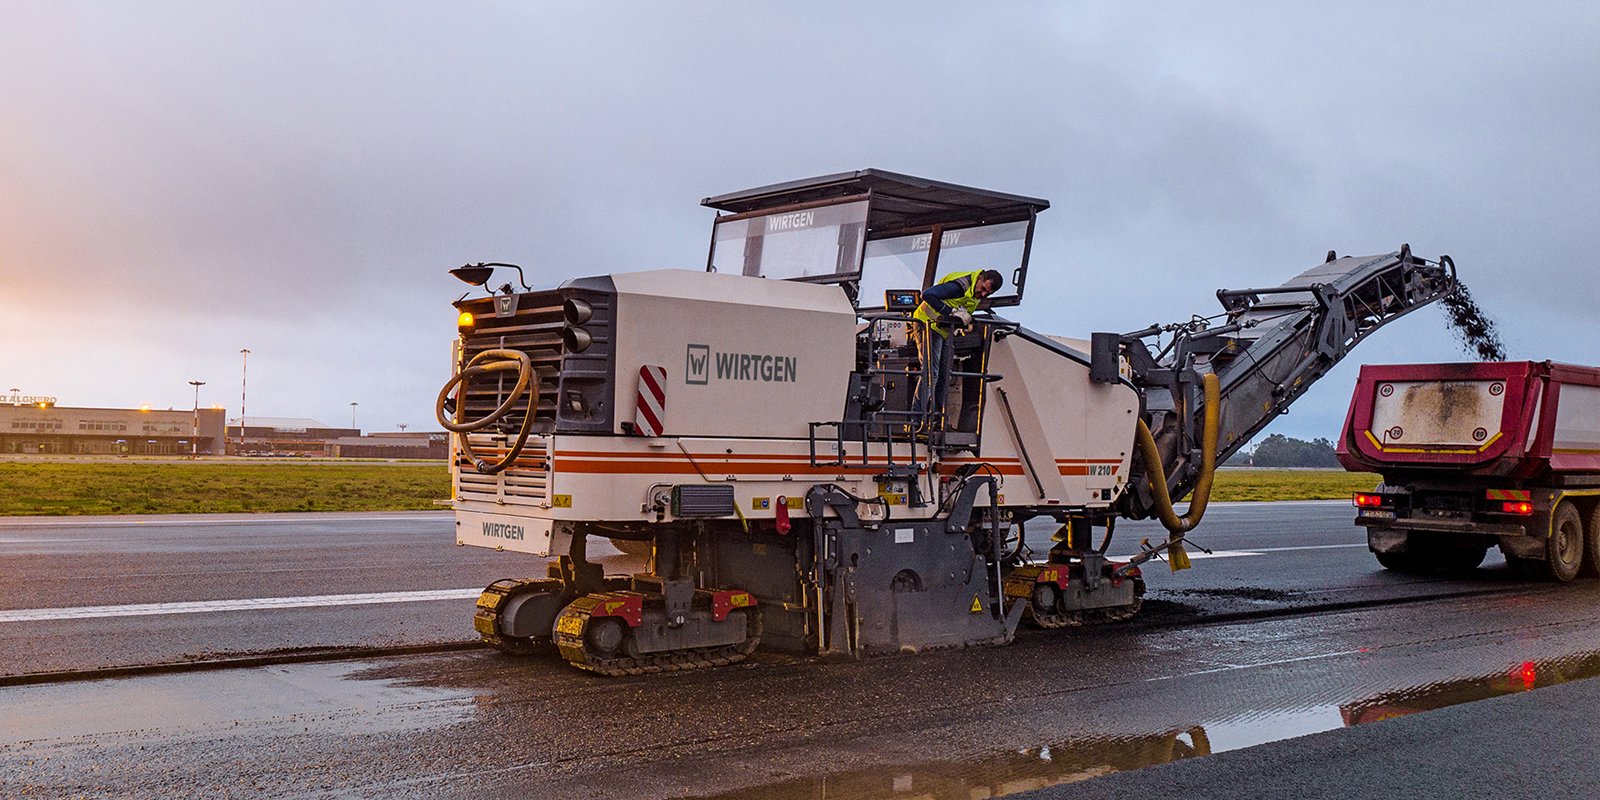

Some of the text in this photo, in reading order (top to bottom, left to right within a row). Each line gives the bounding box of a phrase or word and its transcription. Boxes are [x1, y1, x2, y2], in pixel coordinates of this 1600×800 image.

[770, 211, 814, 230] WIRTGEN
[716, 352, 796, 382] WIRTGEN
[1090, 465, 1111, 476] W 210
[482, 521, 524, 540] WIRTGEN
